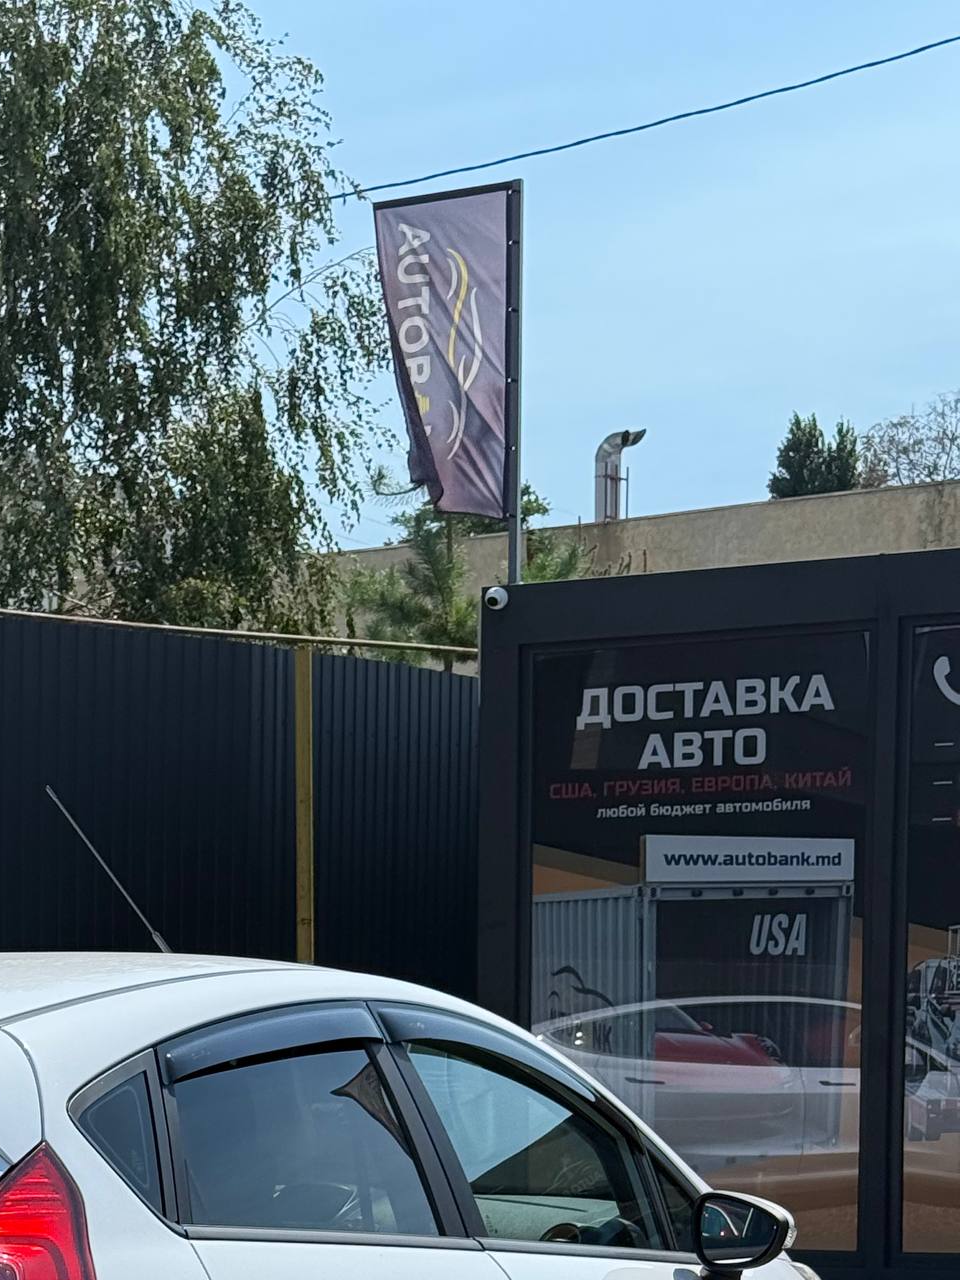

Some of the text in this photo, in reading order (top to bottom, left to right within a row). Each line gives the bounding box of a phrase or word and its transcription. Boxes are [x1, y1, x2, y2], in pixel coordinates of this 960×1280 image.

[576, 674, 835, 731] ДОСТАВКА
[637, 728, 767, 770] АВТО
[784, 766, 852, 789] КИТАЙ
[596, 798, 811, 819] любой бюджет автомобиля
[663, 851, 842, 868] www.autobank.md
[749, 913, 808, 956] USA
